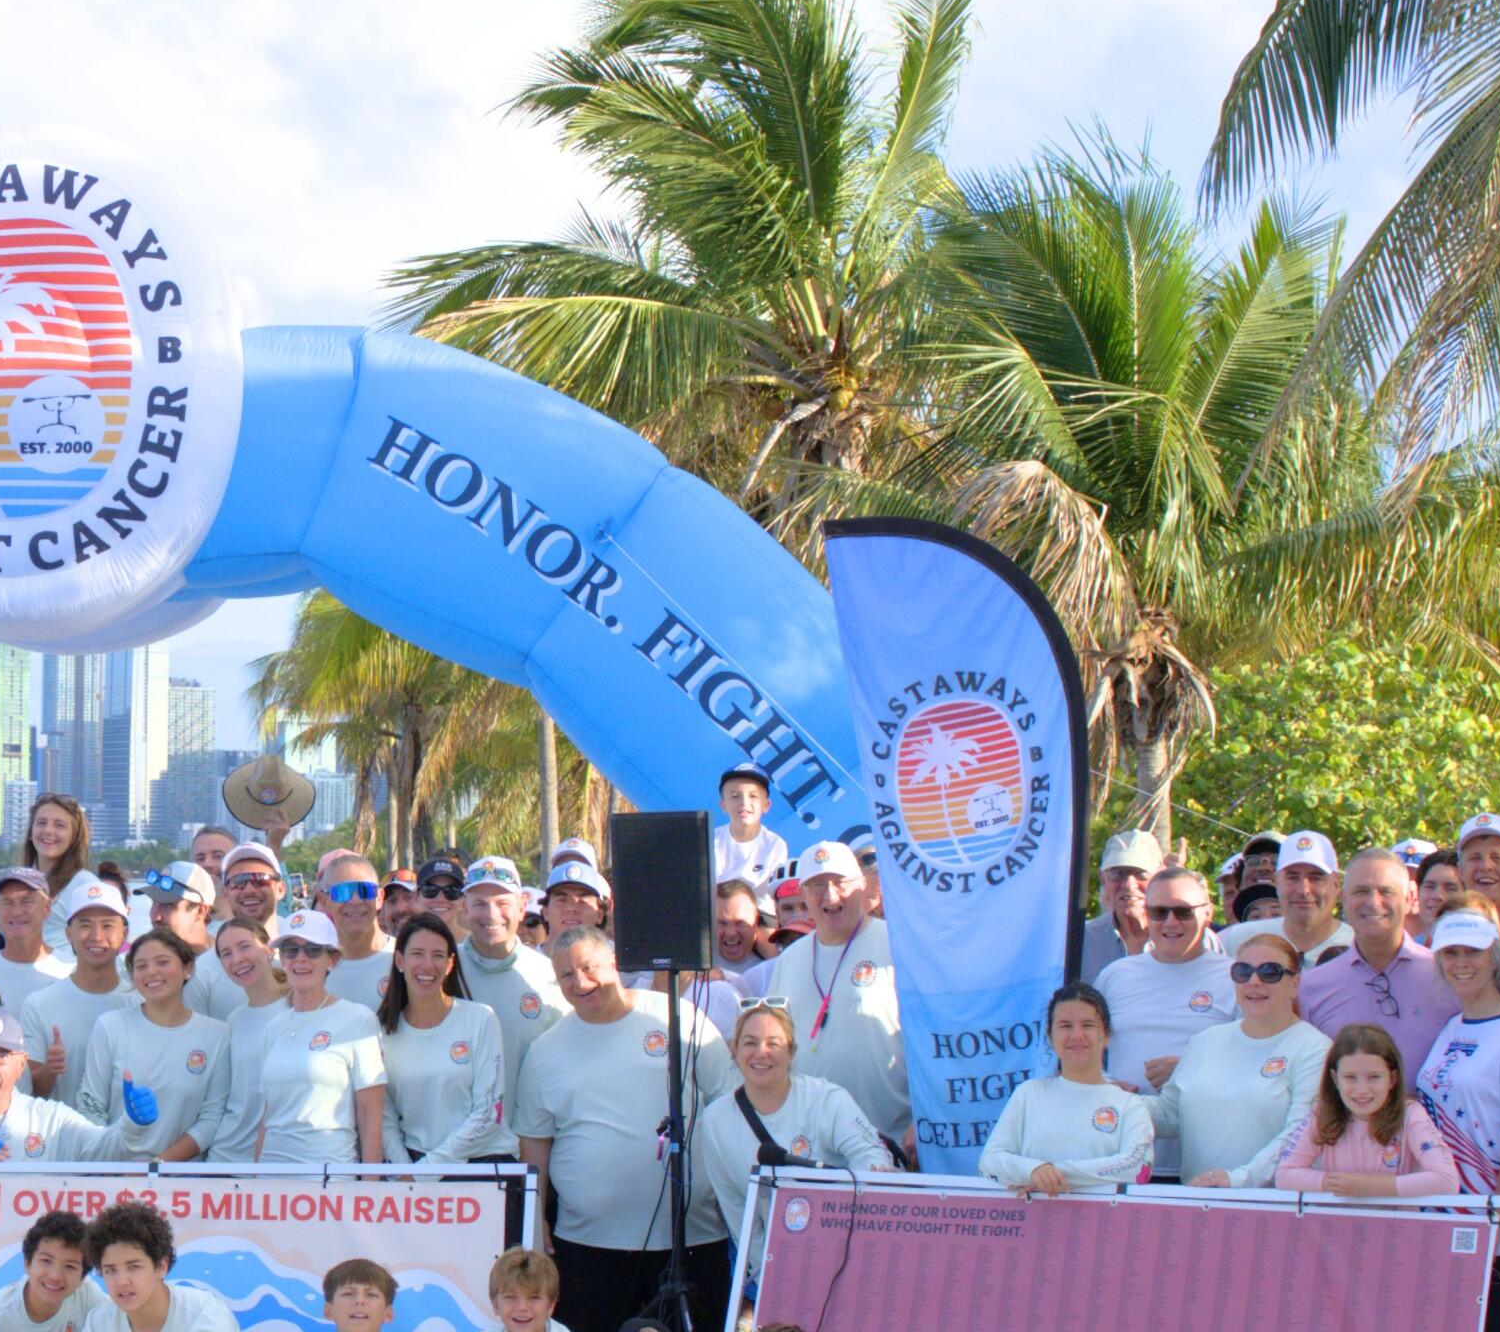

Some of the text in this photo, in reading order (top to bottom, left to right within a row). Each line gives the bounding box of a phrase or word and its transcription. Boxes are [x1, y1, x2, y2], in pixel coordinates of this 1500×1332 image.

[19, 440, 93, 454] EST. 2000
[28, 385, 189, 571] CANCER
[366, 415, 846, 830] HONOR. FIGHT.
[871, 670, 1036, 761] CASTAWAYS
[874, 801, 976, 893] AGAINST
[986, 773, 1050, 887] CANCER
[946, 1069, 1033, 1104] FIGH
[916, 1118, 997, 1148] CELE
[12, 1190, 106, 1218] OVER
[200, 1193, 343, 1222] MILLION
[352, 1196, 482, 1224] RAISED
[821, 1201, 1026, 1221] IN HONOR OF OUR LOVED ONES
[820, 1217, 1025, 1239] WHO HAVE FOUGHT THE FIGHT.
